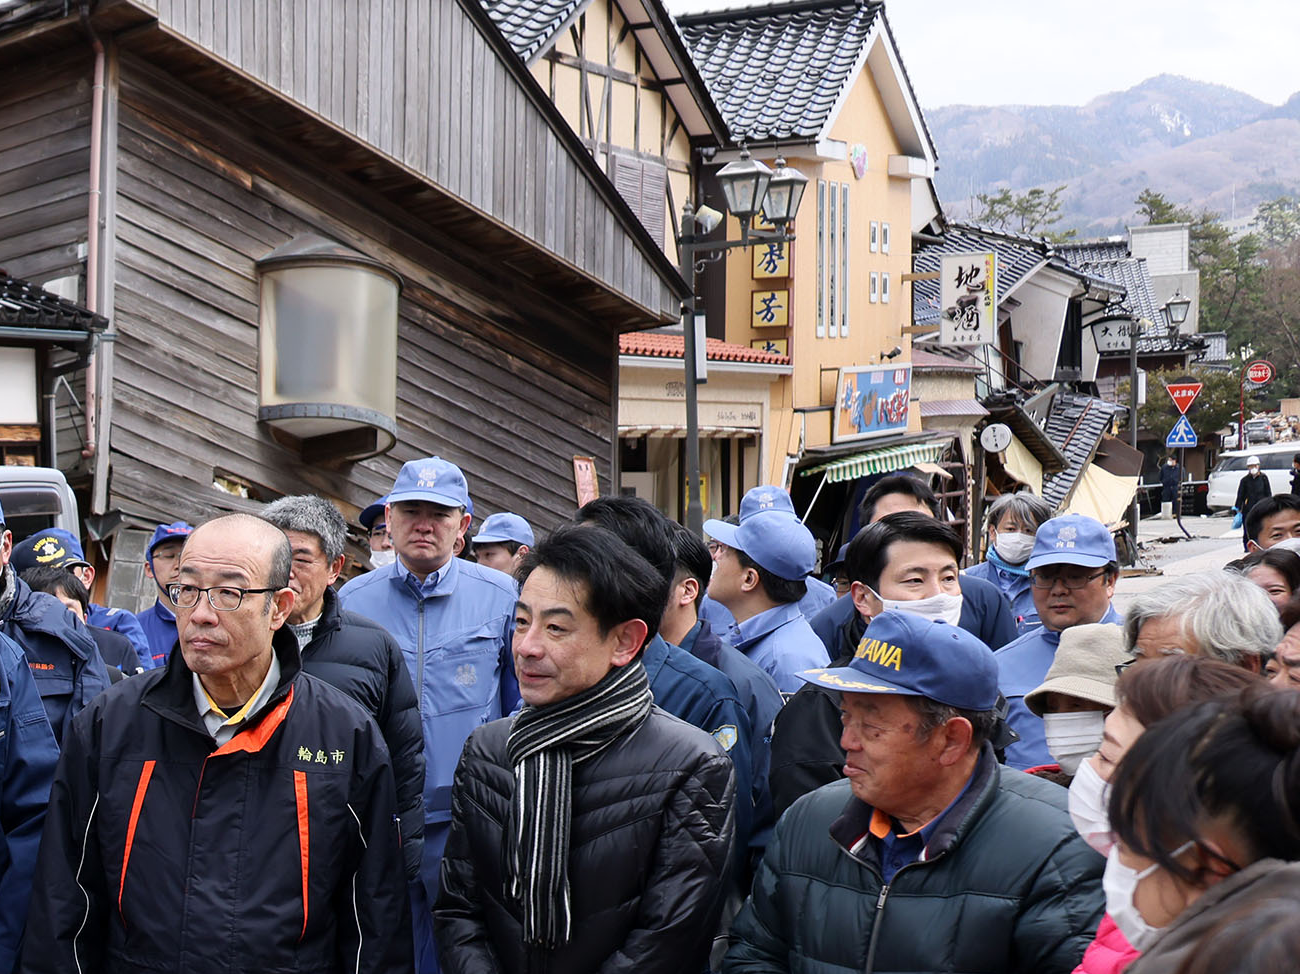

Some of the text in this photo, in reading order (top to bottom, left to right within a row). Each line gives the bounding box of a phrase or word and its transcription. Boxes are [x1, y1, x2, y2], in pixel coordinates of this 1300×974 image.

[954, 264, 981, 331] 地酒
[297, 745, 345, 765] 輪島市
